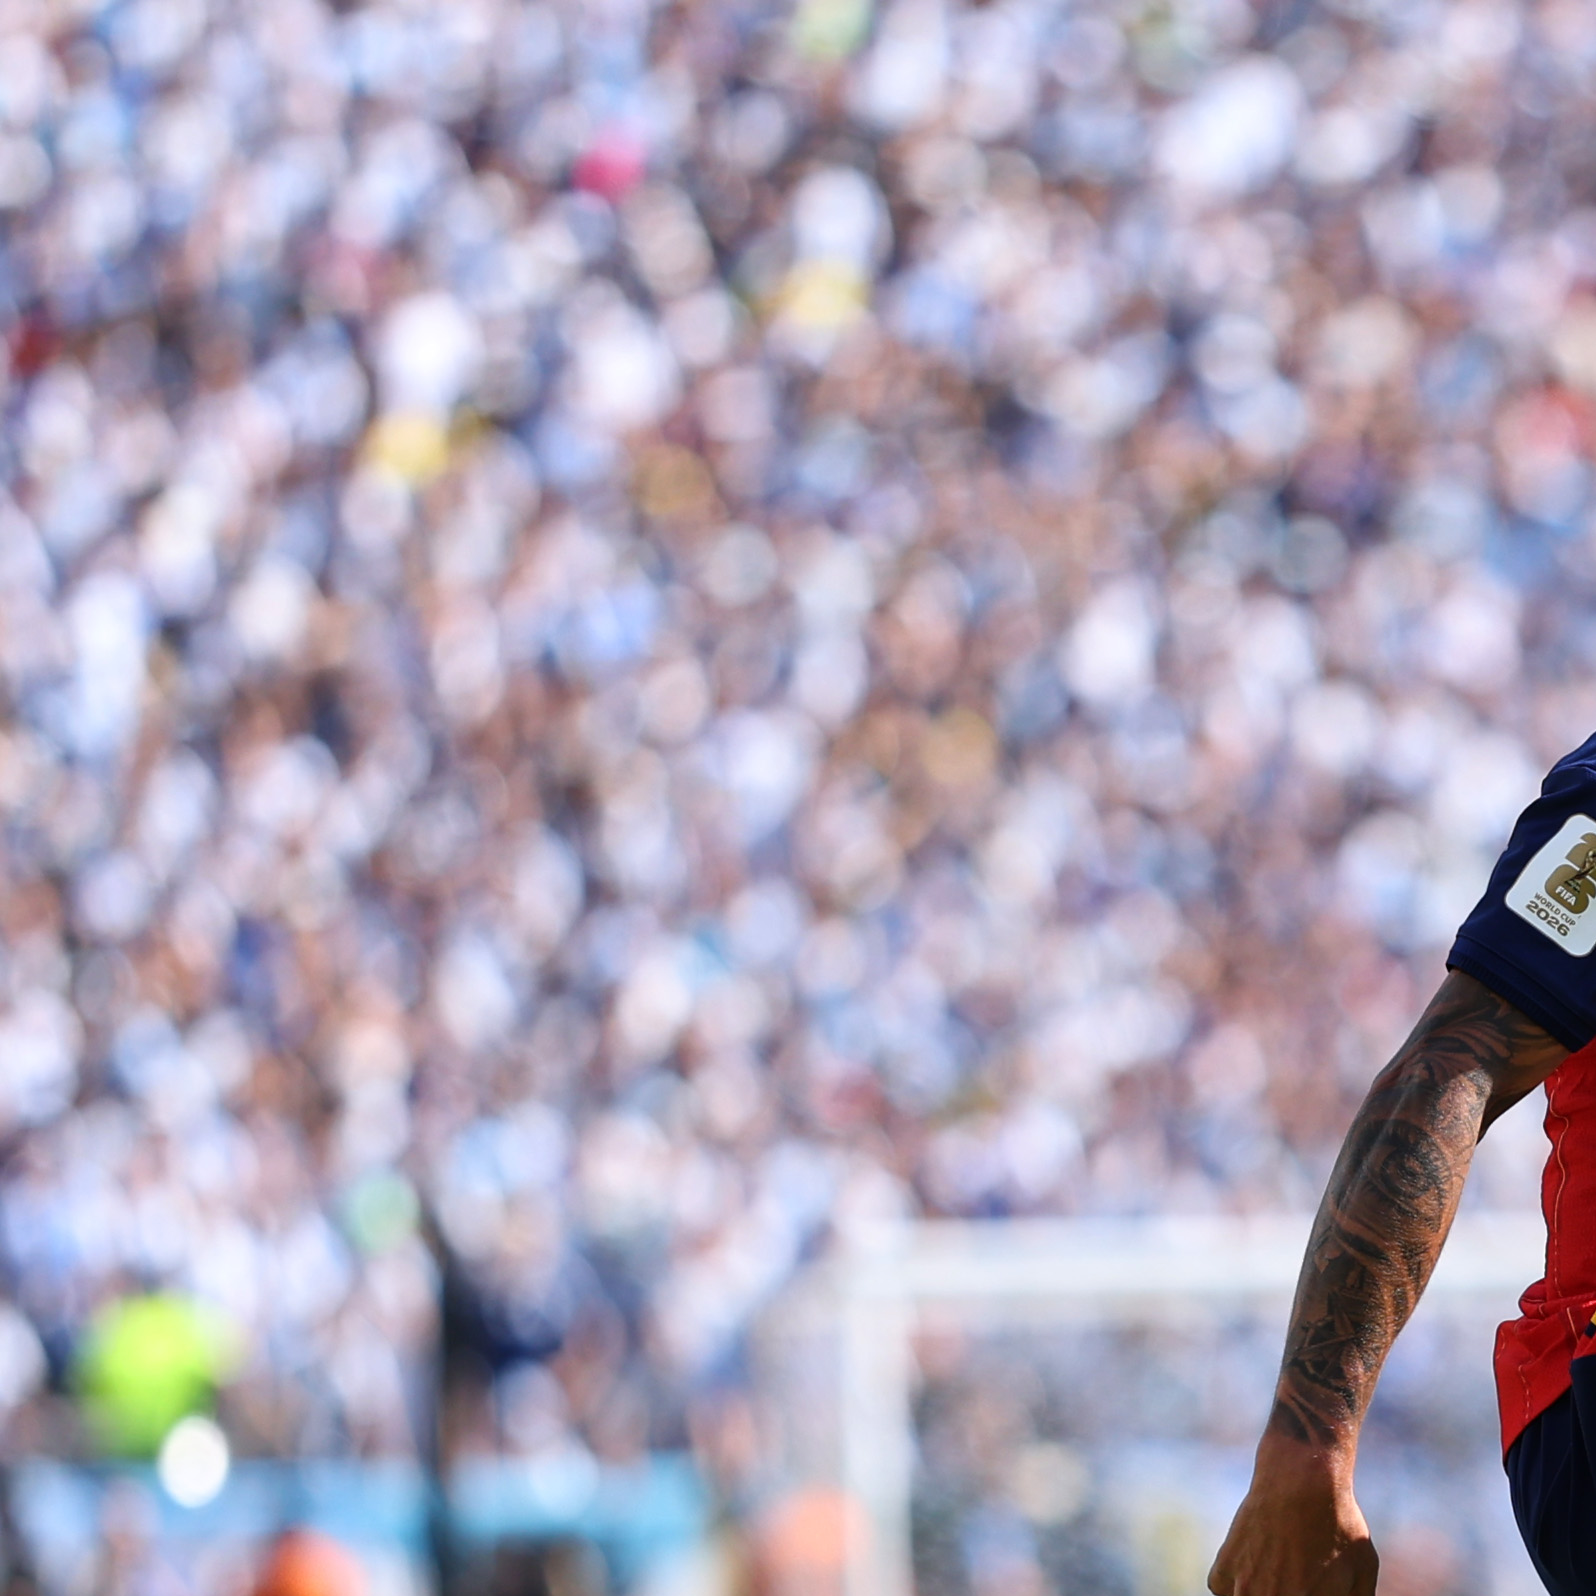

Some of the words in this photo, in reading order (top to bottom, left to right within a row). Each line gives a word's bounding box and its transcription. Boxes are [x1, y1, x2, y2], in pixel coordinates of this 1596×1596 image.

[1534, 892, 1561, 915] WORLD
[1560, 913, 1577, 927] CUP
[1555, 885, 1578, 907] FIFA
[1525, 900, 1570, 937] 2026
